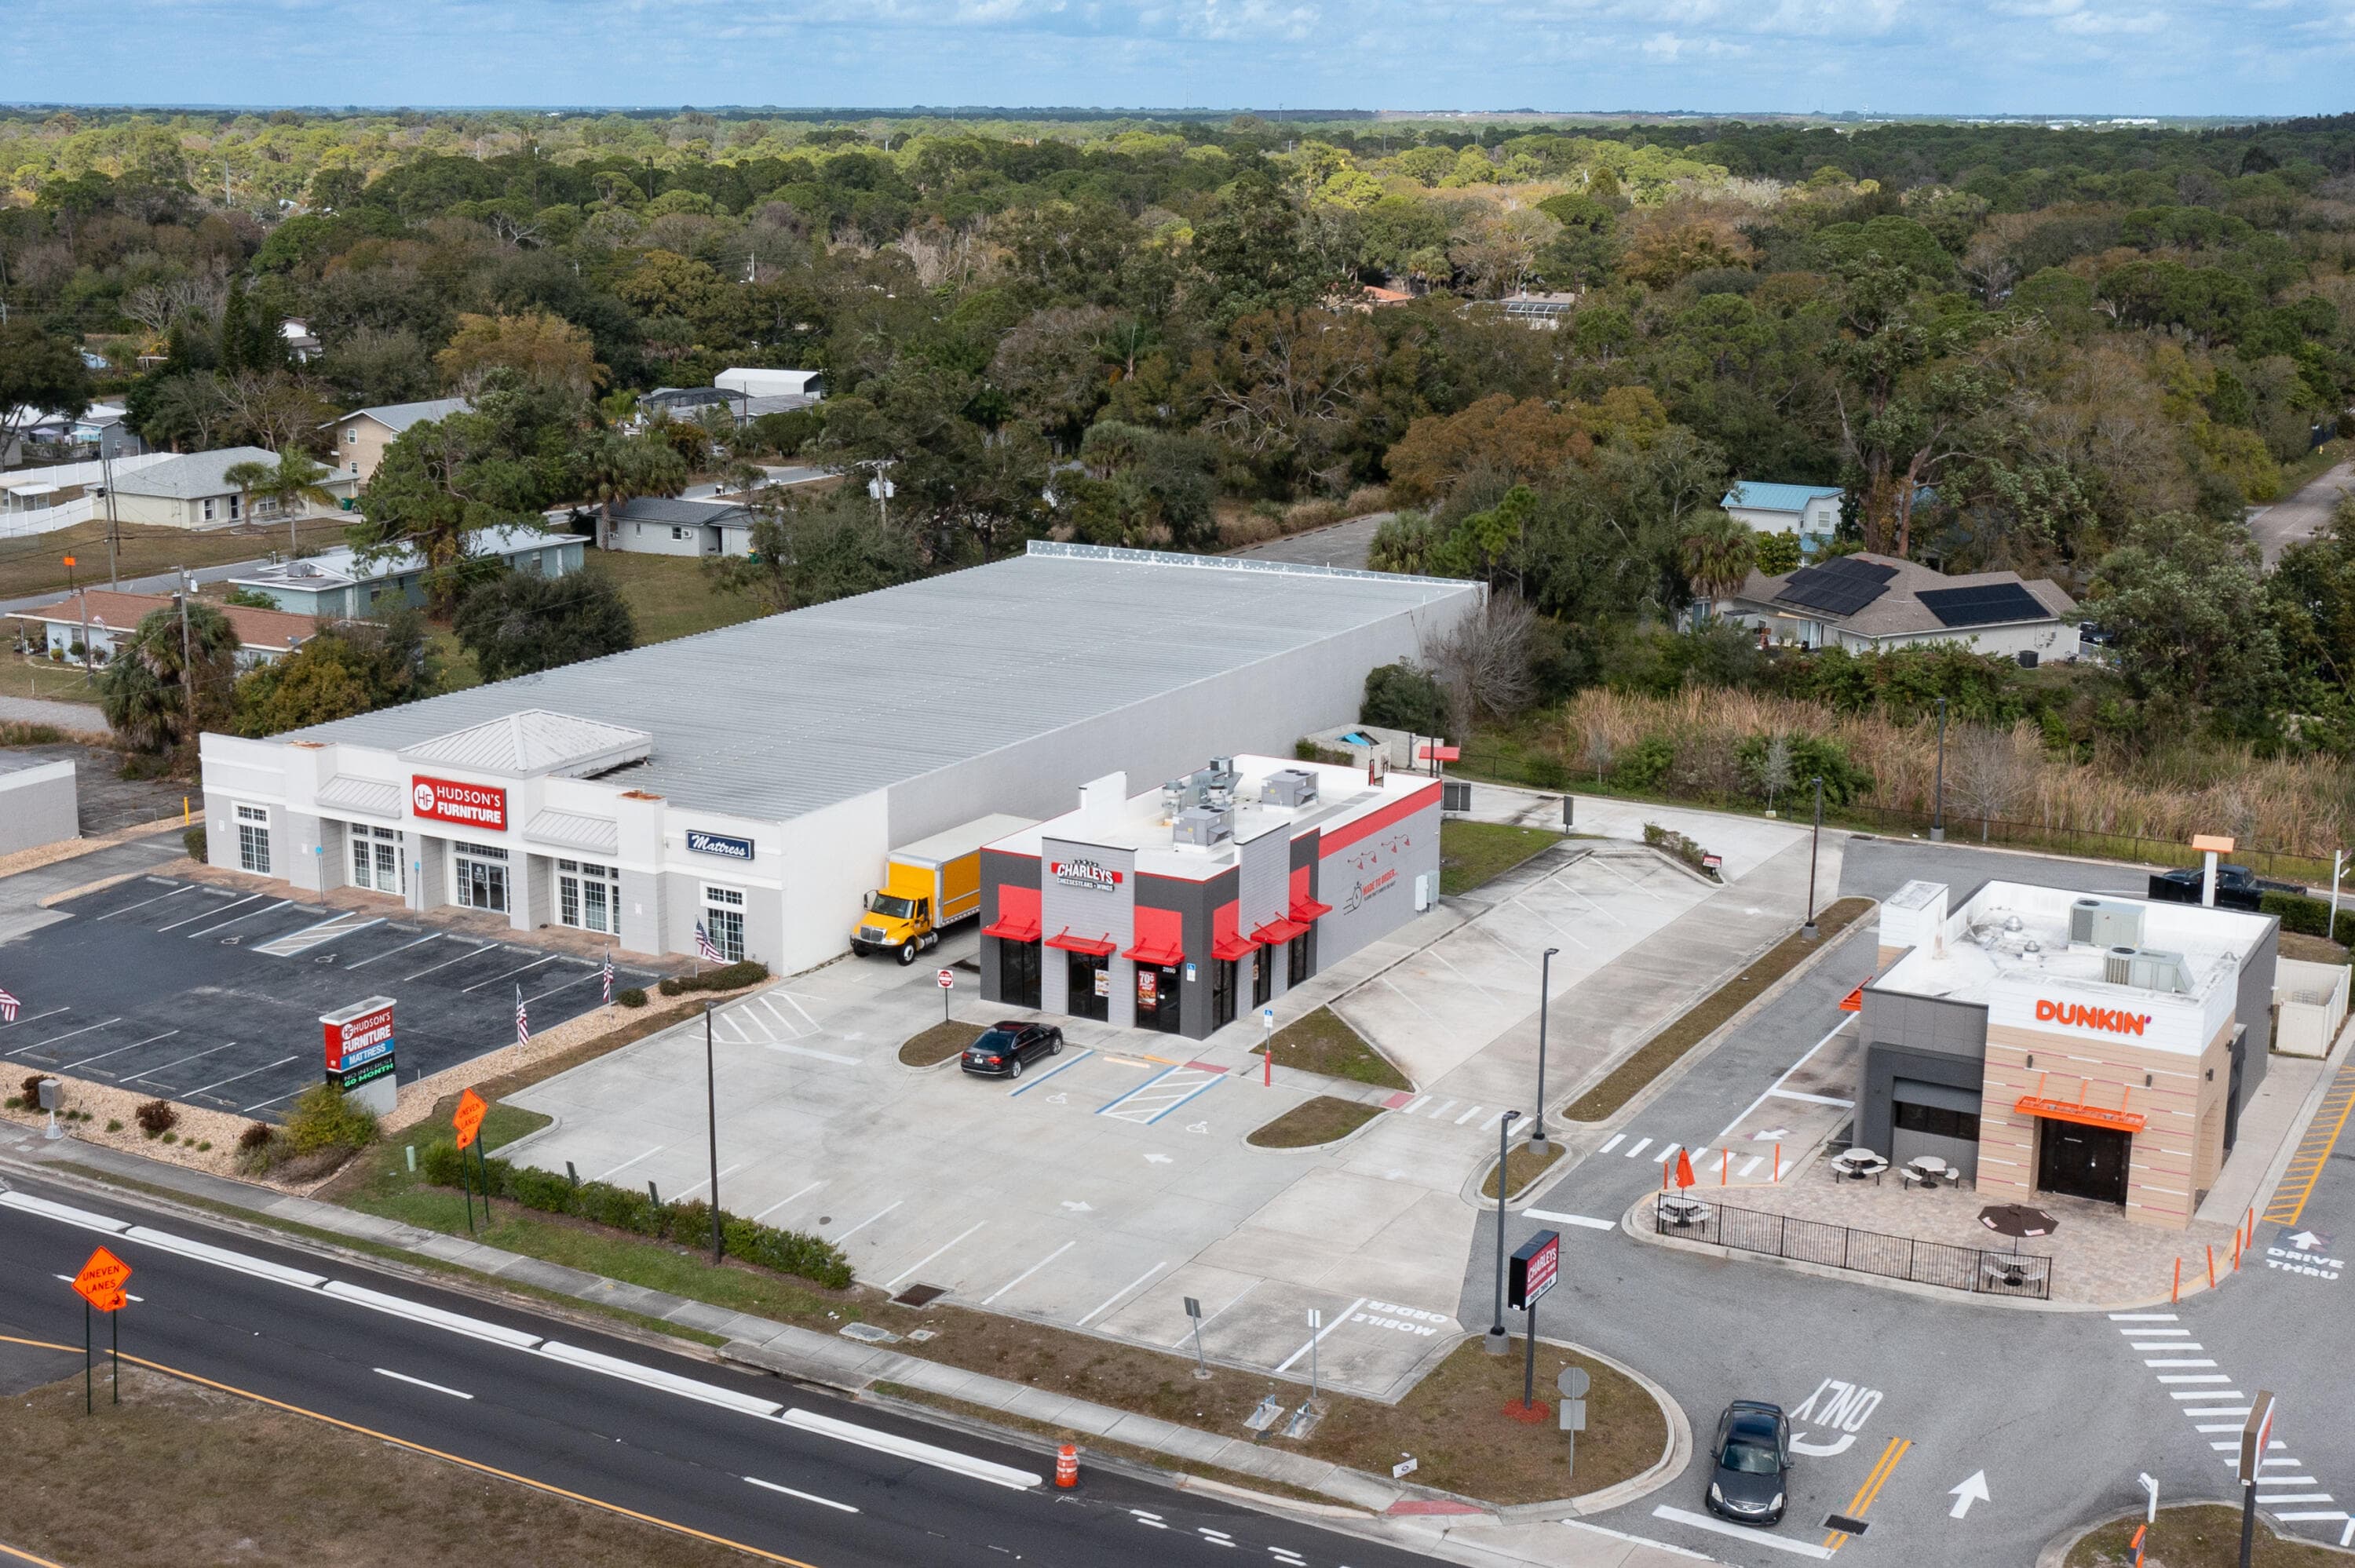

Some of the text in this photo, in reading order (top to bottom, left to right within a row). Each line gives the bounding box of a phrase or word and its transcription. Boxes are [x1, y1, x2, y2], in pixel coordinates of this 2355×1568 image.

[436, 786, 501, 808] HUDSON'S
[437, 801, 502, 824] FURNITURE
[692, 834, 746, 856] Mattress
[1057, 864, 1114, 884] CHARLEYS
[353, 1012, 391, 1034] HUDSON'S
[2036, 999, 2152, 1036] DUNKIN'
[342, 1024, 391, 1055] FURNITURE
[349, 1043, 386, 1065] MATTRESS
[344, 1058, 392, 1081] NO INTEREST
[344, 1063, 394, 1088] 60 MONTH
[459, 1103, 480, 1118] UNEVEN
[462, 1115, 479, 1129] LANES
[1527, 1248, 1557, 1282] CHARLEYS
[2267, 1247, 2345, 1268] DRIVE
[82, 1265, 119, 1281] UNEVEN
[2266, 1259, 2339, 1280] THRU
[86, 1279, 115, 1294] LANES
[1367, 1300, 1448, 1323] ORDER
[1351, 1313, 1437, 1336] MOBILE
[1789, 1377, 1884, 1433] ONLY
